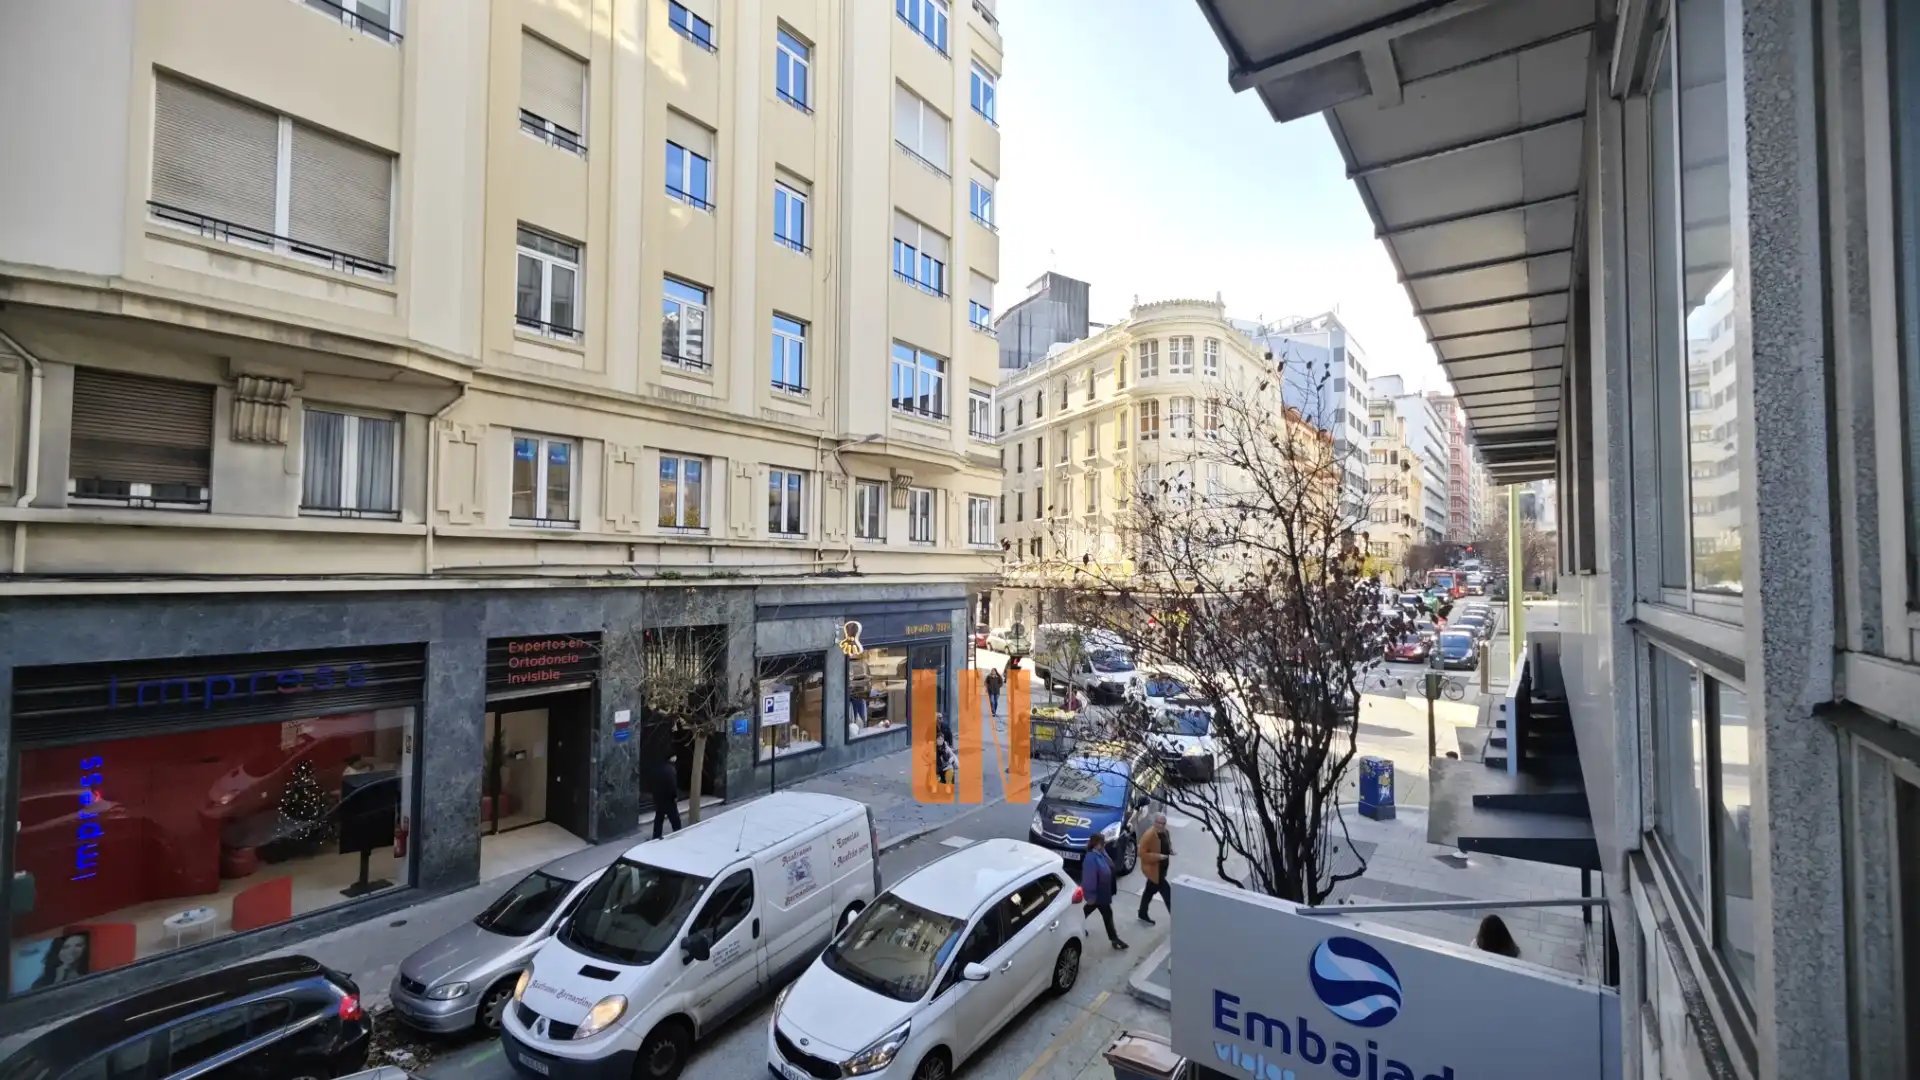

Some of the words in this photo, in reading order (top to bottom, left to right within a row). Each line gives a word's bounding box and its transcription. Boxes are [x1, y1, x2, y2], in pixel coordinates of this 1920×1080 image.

[508, 640, 566, 654] Expertos
[567, 639, 584, 649] en
[508, 652, 579, 669] Ortodoncia
[508, 668, 561, 684] Invisible
[765, 698, 774, 713] P
[1052, 814, 1092, 829] SER
